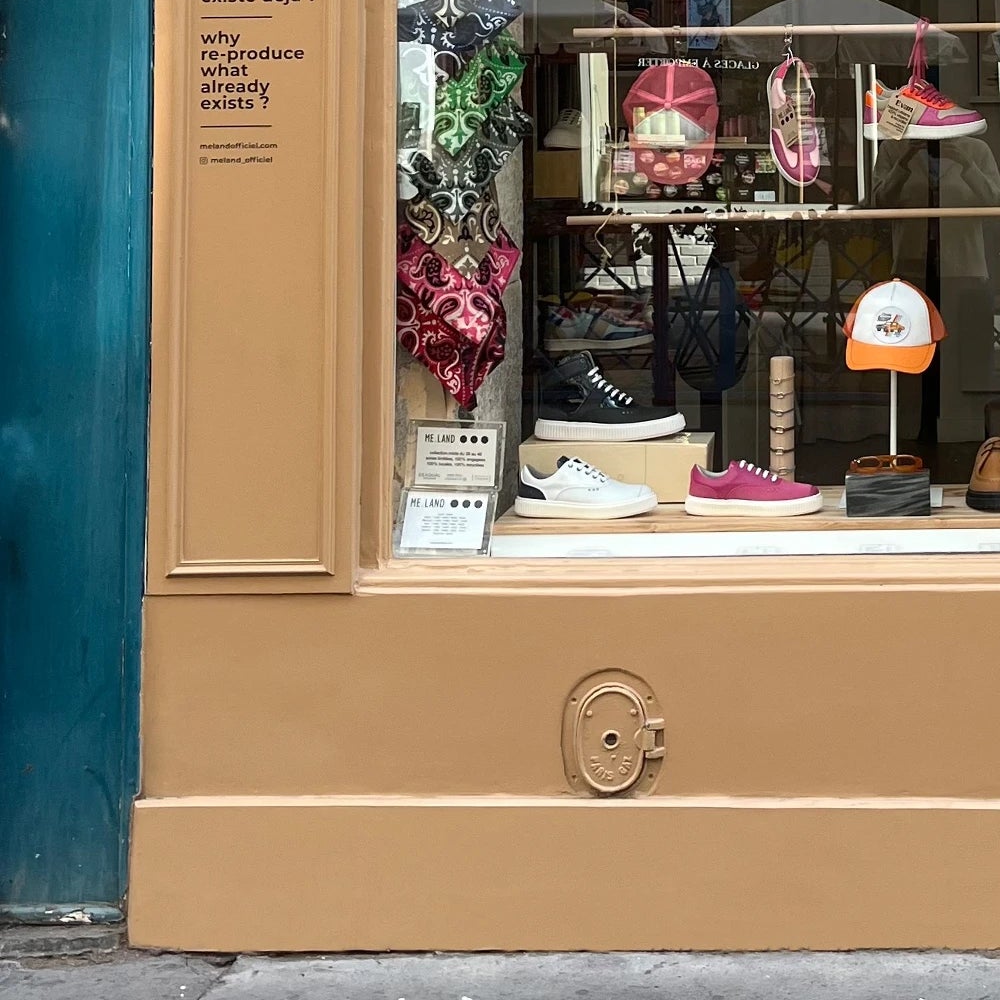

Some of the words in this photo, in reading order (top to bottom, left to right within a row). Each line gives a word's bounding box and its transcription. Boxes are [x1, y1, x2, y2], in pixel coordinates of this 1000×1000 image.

[201, 31, 241, 47] why
[201, 47, 305, 63] re-produce
[201, 64, 249, 77] what
[201, 79, 270, 96] already
[200, 95, 254, 110] exists
[260, 96, 270, 109] ?
